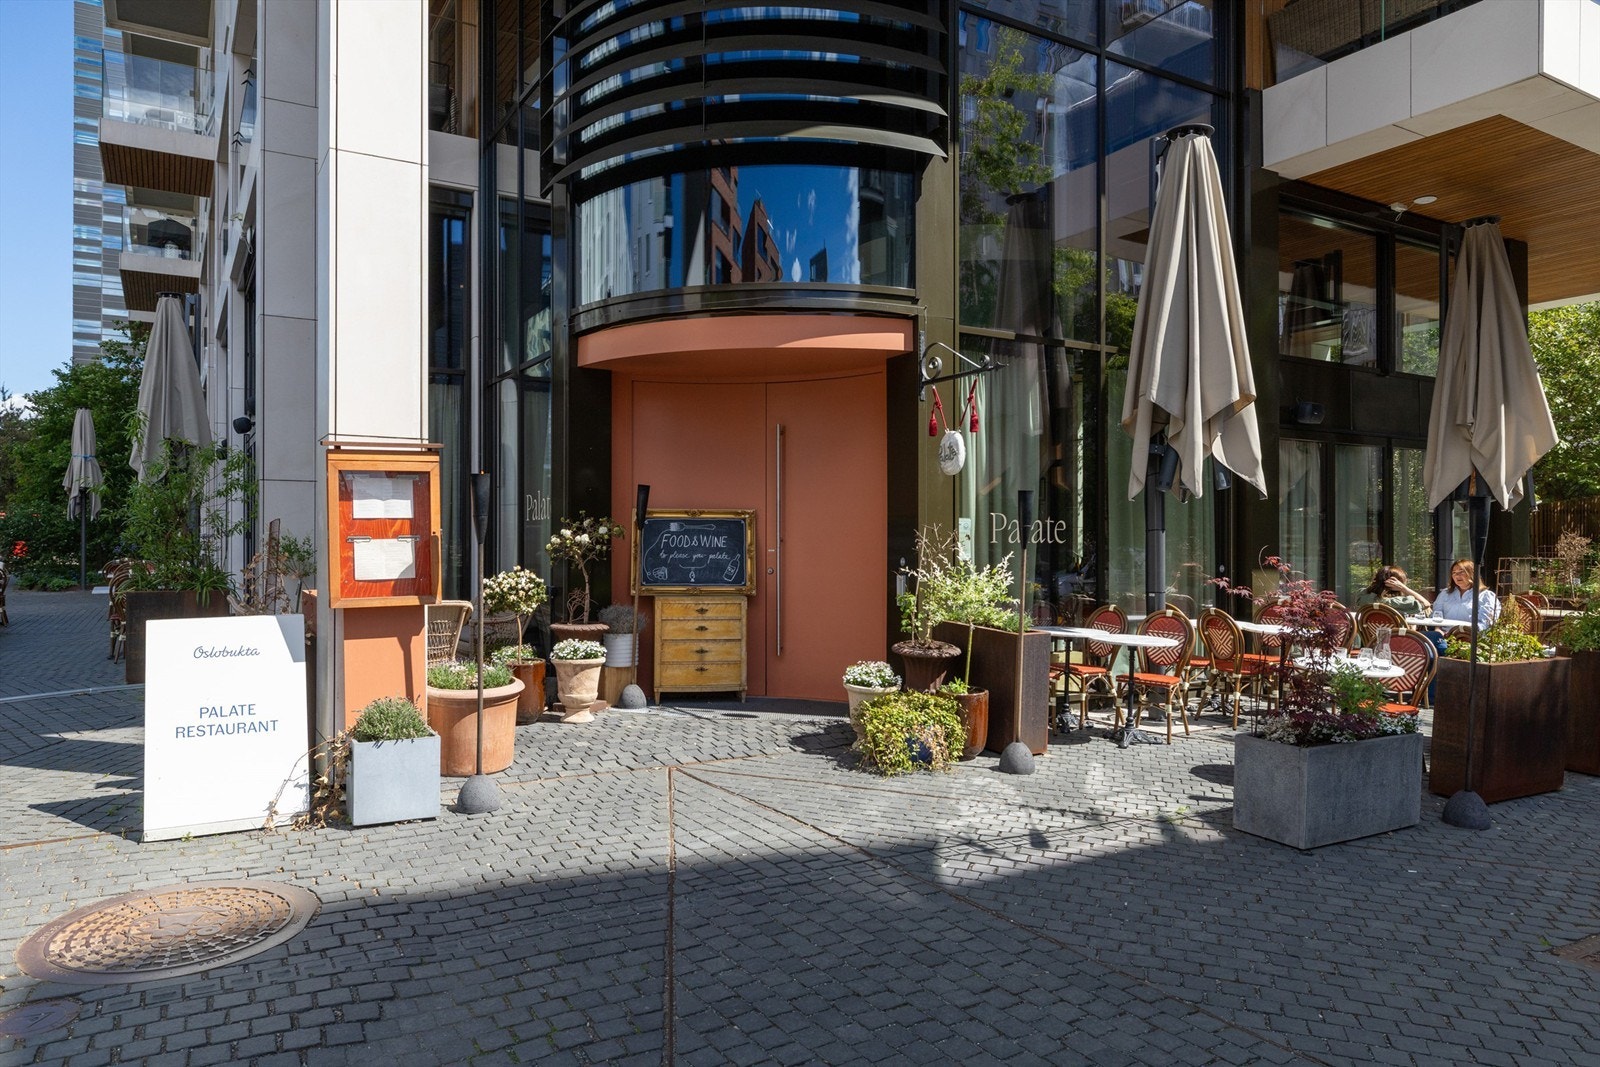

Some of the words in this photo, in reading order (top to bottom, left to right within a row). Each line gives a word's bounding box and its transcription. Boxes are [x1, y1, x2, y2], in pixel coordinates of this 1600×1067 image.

[526, 490, 551, 520] Palat
[990, 512, 1067, 544] Paate
[667, 550, 690, 564] please
[708, 551, 731, 564] palate
[193, 645, 260, 659] Oslobukta
[199, 703, 256, 719] PALATE
[175, 720, 278, 738] RESTAURANT
